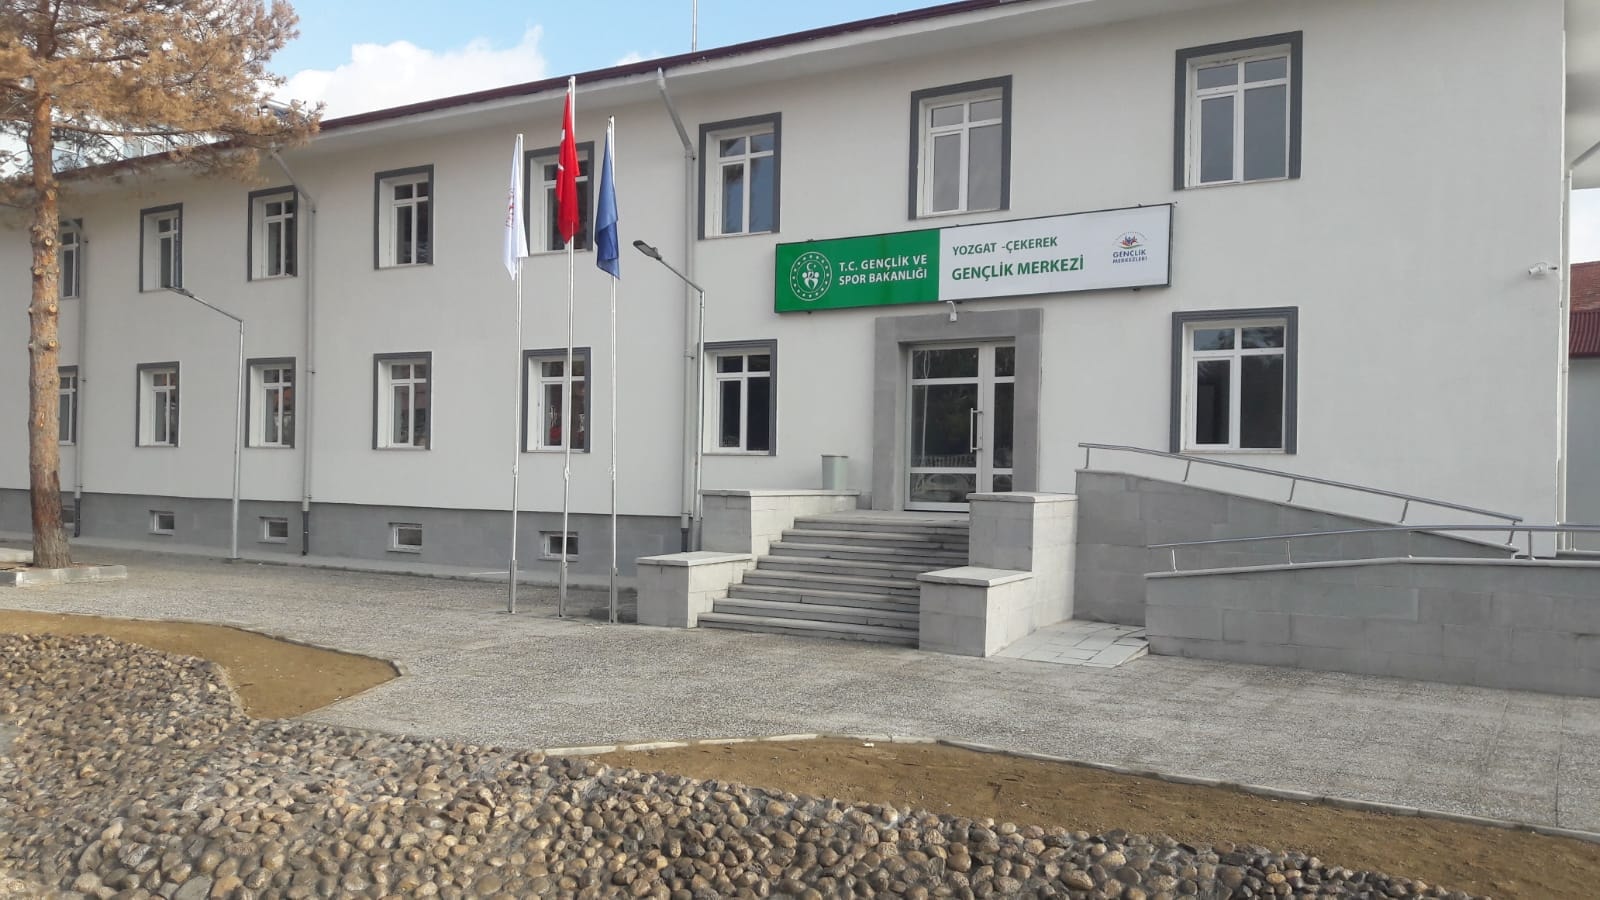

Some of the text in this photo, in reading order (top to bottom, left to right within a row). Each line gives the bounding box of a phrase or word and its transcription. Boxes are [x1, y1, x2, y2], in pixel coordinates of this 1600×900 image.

[952, 242, 997, 256] YOZGAT
[839, 254, 927, 273] T.C. GENÇLİK VE
[952, 254, 1084, 281] GENÇLİK MERKEZİ
[839, 267, 927, 285] SPOR BAKANLIĞI
